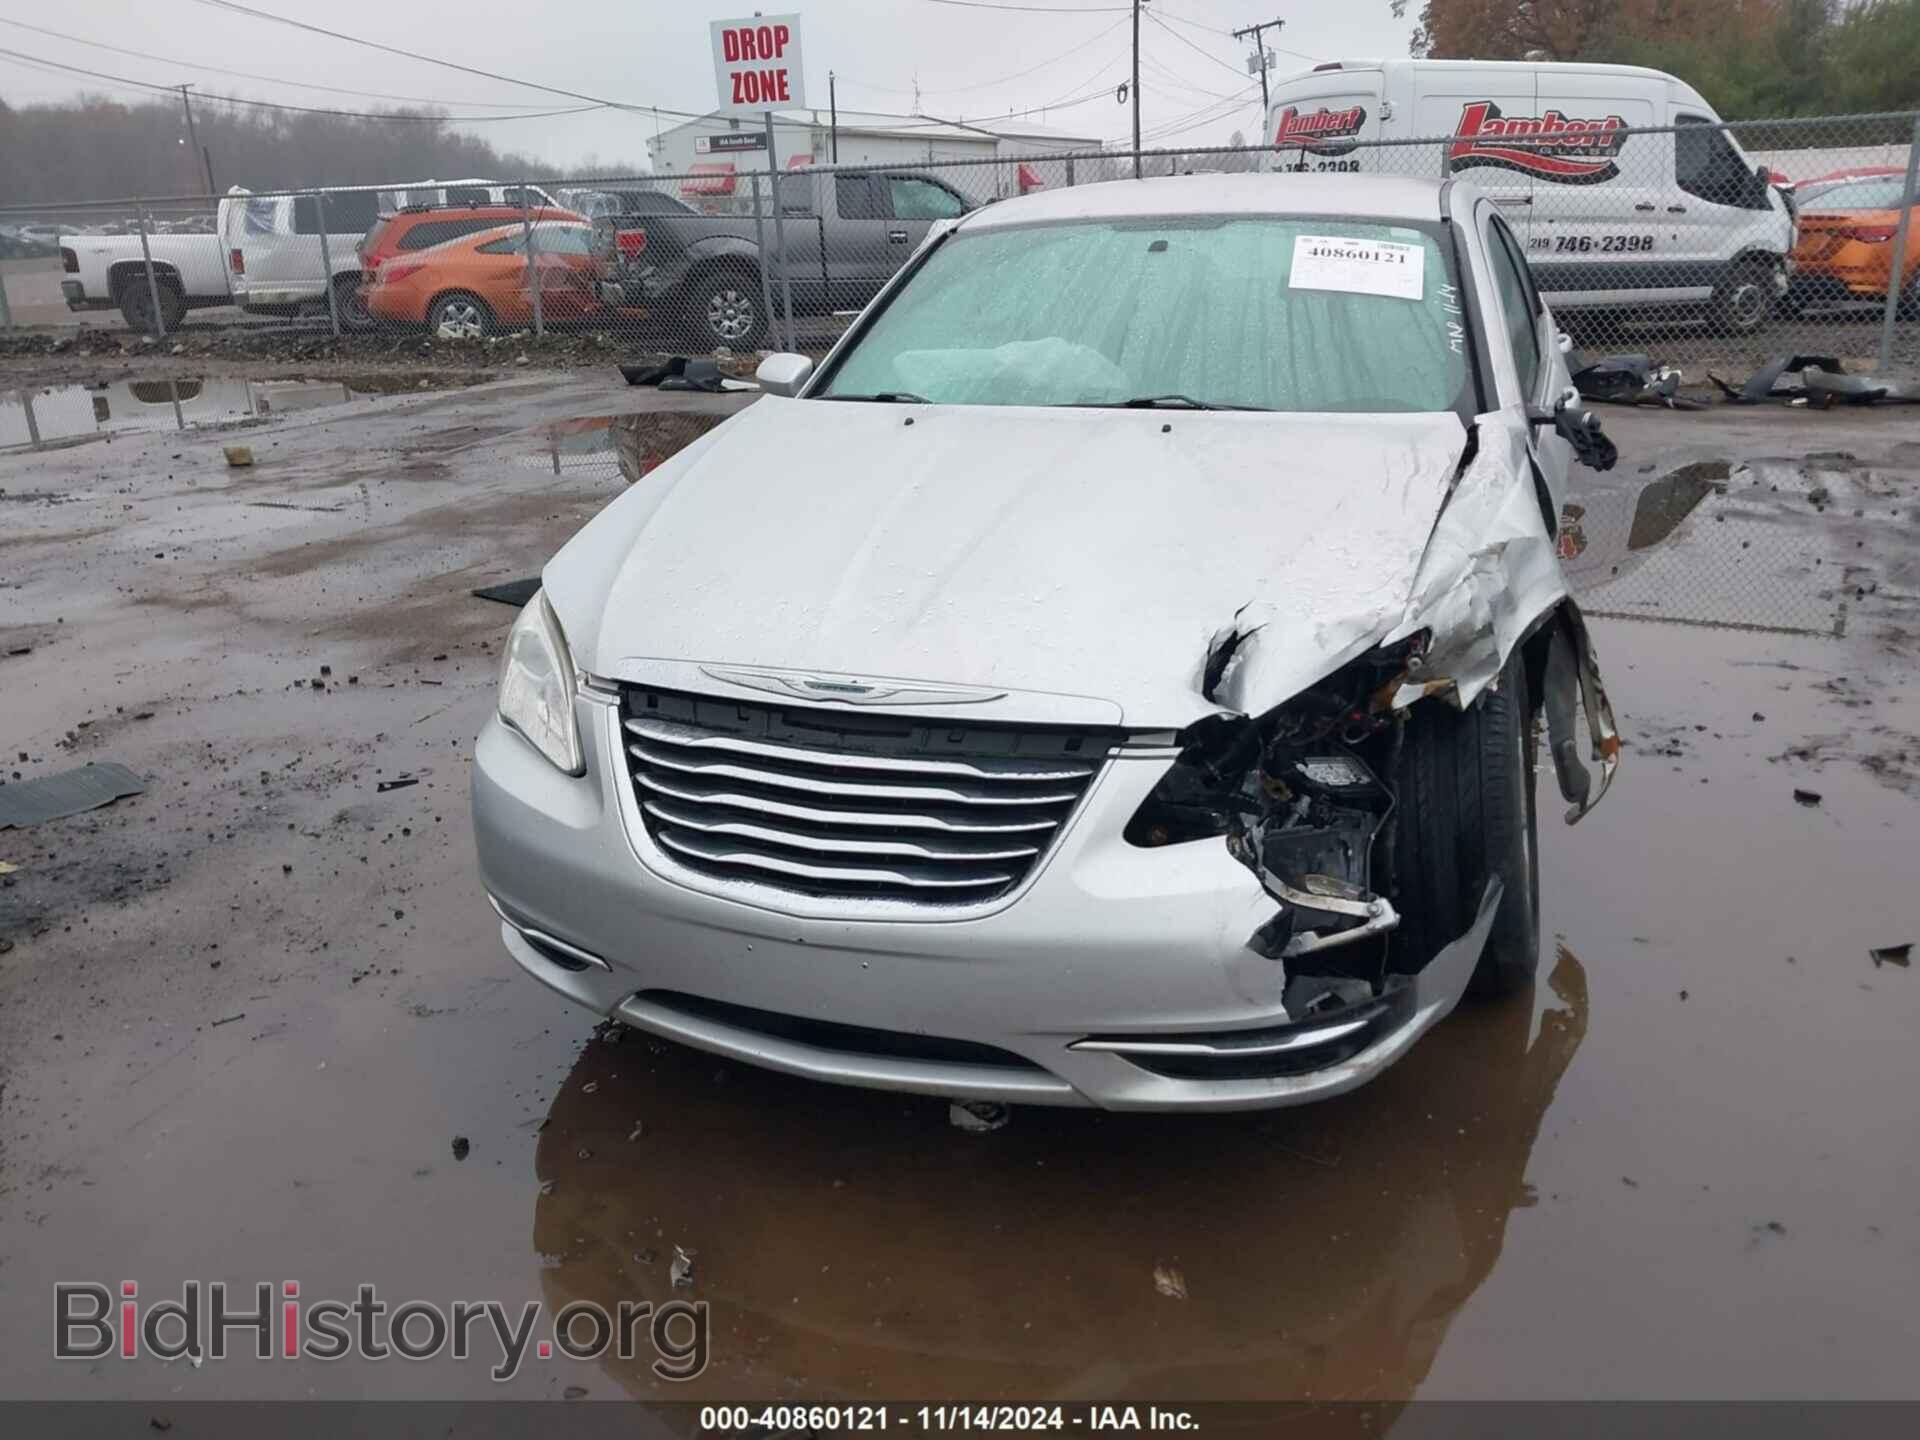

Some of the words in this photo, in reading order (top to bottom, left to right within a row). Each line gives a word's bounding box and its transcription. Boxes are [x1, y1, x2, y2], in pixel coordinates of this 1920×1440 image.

[722, 25, 789, 62] DROP
[730, 69, 790, 104] ZONE
[1275, 107, 1362, 144] Lambert
[1451, 101, 1625, 157] Lambert
[1539, 146, 1619, 157] GLASS
[1307, 247, 1407, 264] 40860121
[1529, 238, 1550, 249] 219
